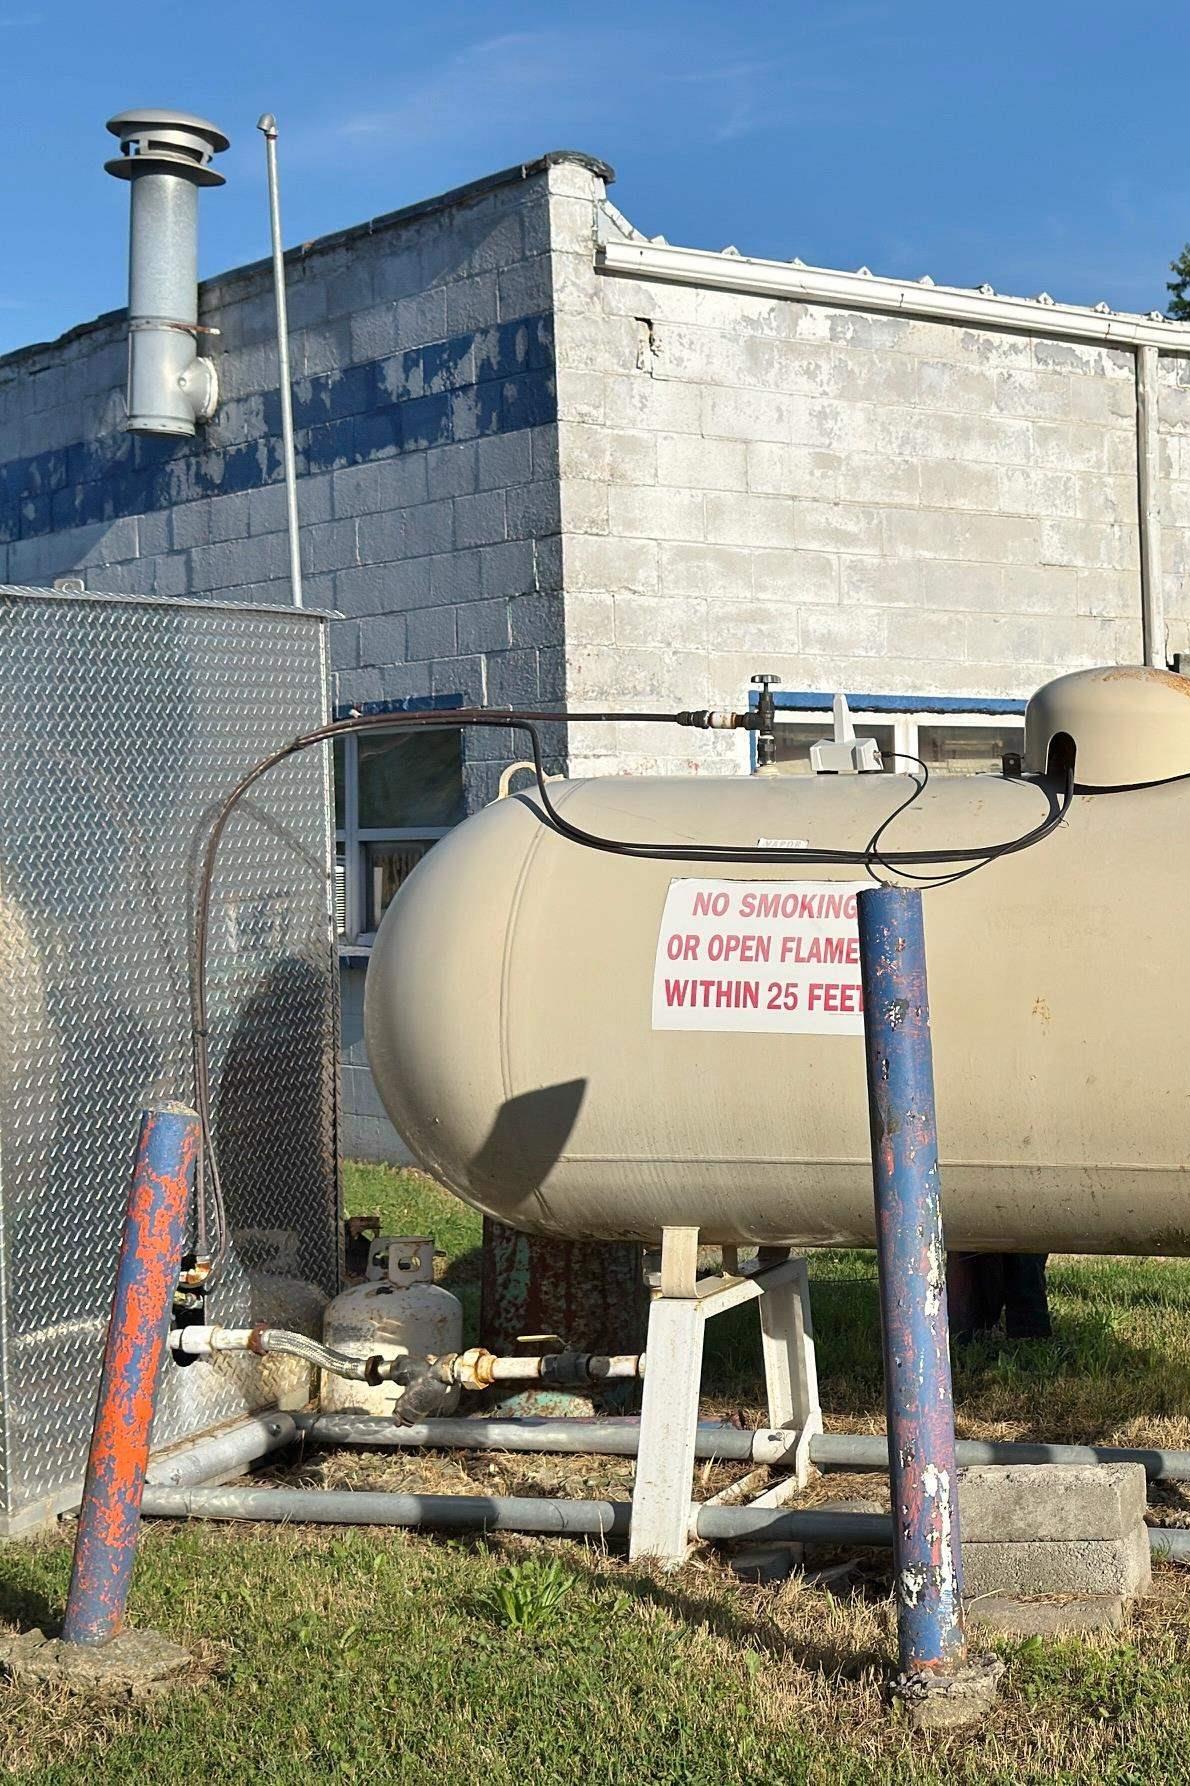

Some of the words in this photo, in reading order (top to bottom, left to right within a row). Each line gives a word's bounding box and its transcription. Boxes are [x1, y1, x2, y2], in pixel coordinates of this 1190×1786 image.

[692, 892, 731, 917] NO
[738, 893, 858, 920] SMOKING
[667, 933, 701, 961] OR
[707, 934, 772, 963] OPEN
[664, 979, 760, 1009] WITHIN
[767, 982, 799, 1011] 25
